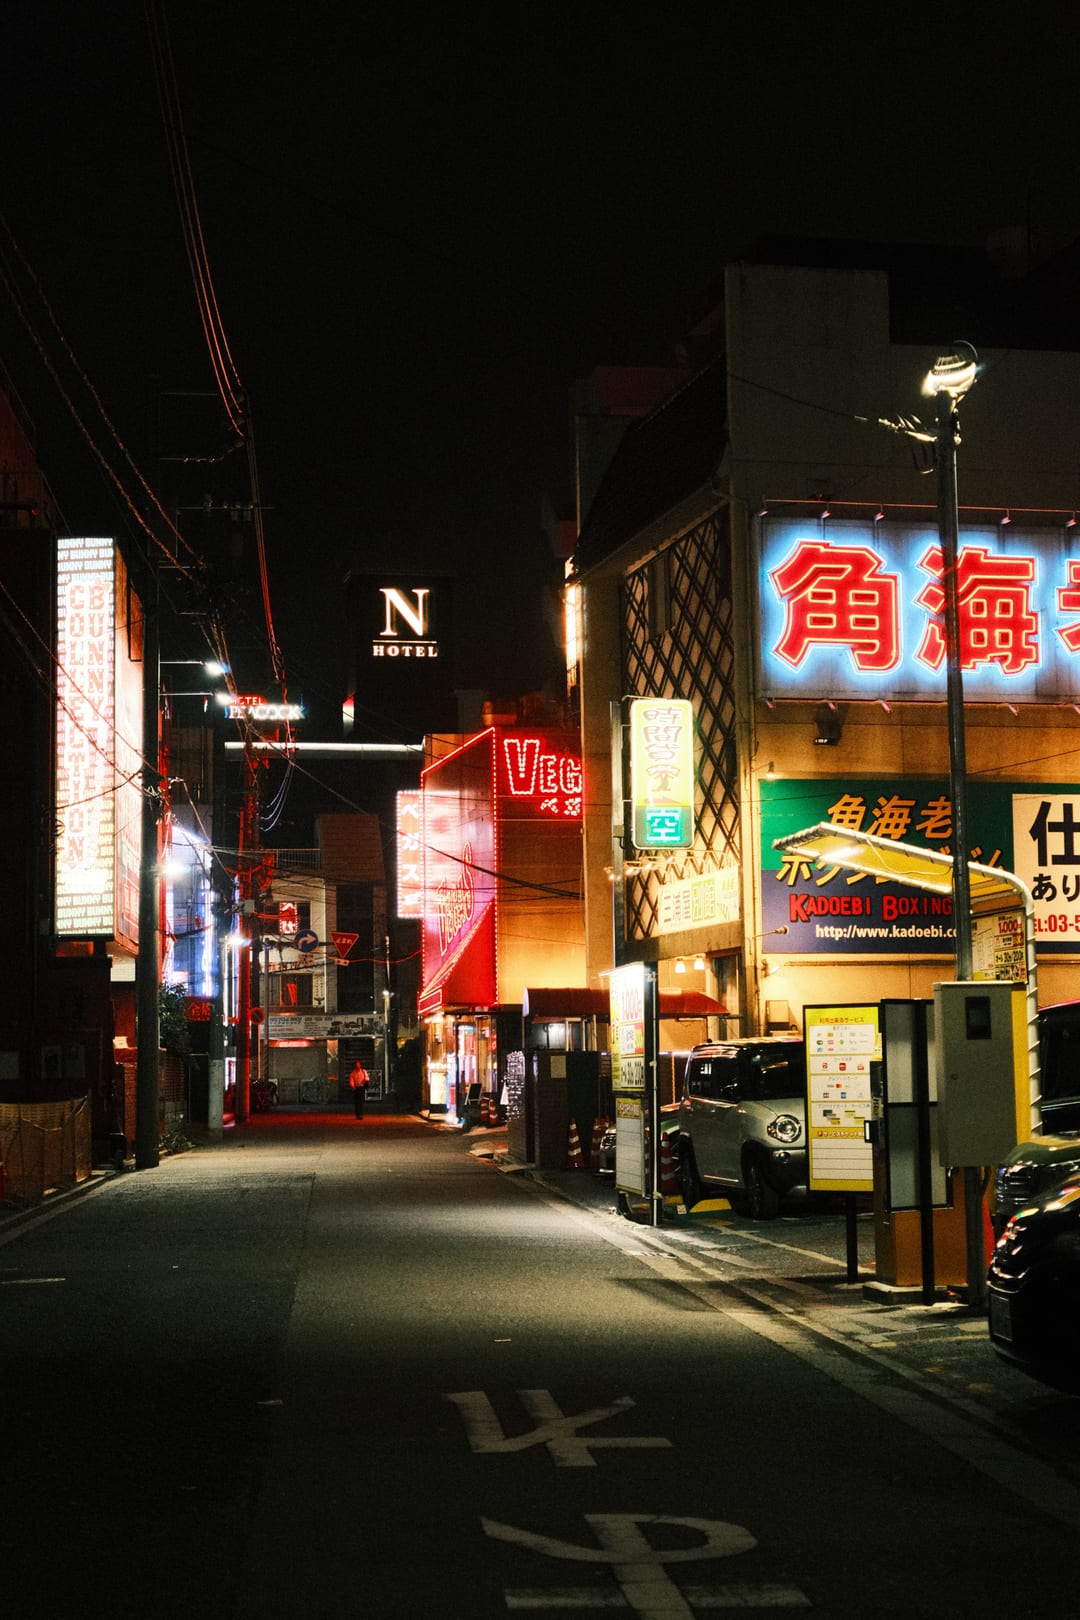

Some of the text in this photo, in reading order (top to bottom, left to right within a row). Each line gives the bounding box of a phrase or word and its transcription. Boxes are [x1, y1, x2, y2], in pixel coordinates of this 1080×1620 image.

[379, 588, 430, 636] N
[770, 540, 1080, 676] 角海
[88, 585, 105, 721] BUNNY
[372, 645, 438, 657] HOTEL
[68, 585, 85, 862] COLLECTION
[229, 705, 300, 720] PEACOCK
[646, 808, 681, 842] 空
[828, 793, 953, 840] 角海老
[789, 893, 953, 922] KADOEBI BOXING
[1032, 873, 1080, 902] あり
